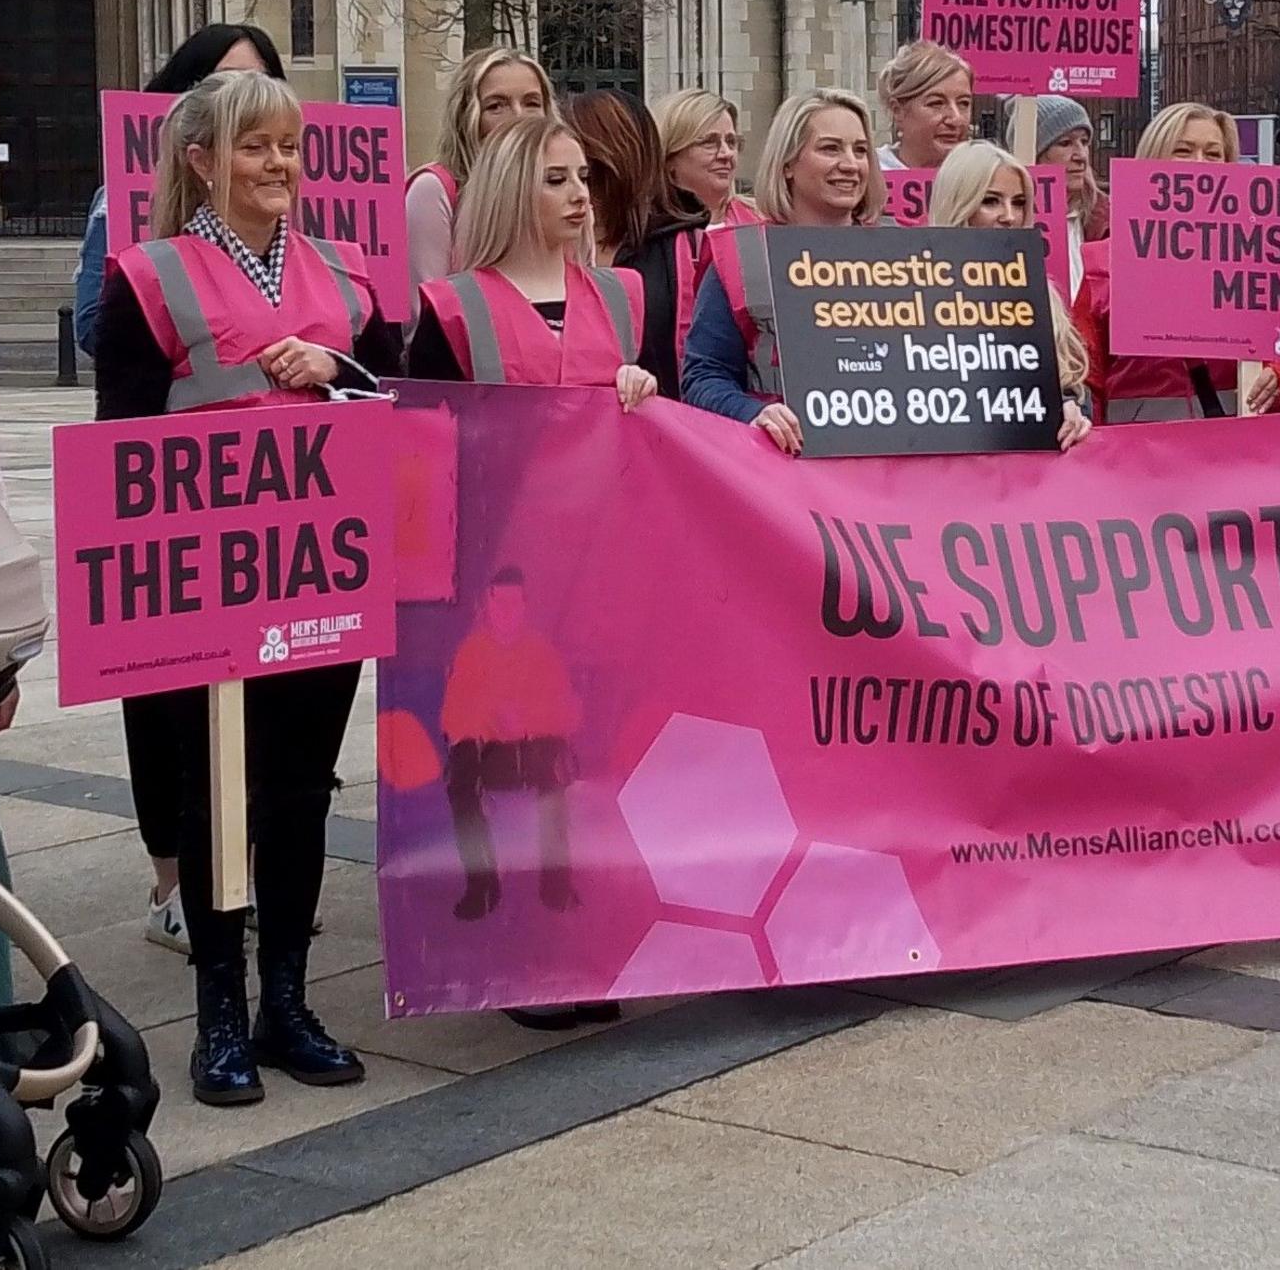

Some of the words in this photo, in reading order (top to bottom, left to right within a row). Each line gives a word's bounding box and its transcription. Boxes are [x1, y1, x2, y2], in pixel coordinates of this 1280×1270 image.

[931, 12, 1051, 52] DOMESTIC
[1056, 18, 1134, 55] ABUSE
[301, 123, 390, 185] OUSE
[1149, 172, 1239, 215] 35%
[333, 197, 389, 257] N.I.
[788, 250, 954, 288] domestic
[962, 251, 1028, 287] and
[814, 292, 925, 328] sexual
[934, 291, 1034, 327] abuse
[837, 358, 883, 373] Nexus
[903, 332, 1040, 382] helpline
[805, 388, 897, 427] 0808
[906, 387, 970, 425] 802
[976, 386, 1047, 423] 1414
[114, 423, 336, 520] BREAK
[75, 535, 203, 626] THE
[220, 517, 370, 607] BIAS
[809, 509, 950, 640] WE
[809, 675, 1002, 748] VICTIMS
[1013, 676, 1059, 747] OF
[1064, 667, 1274, 747] DOMESTIC
